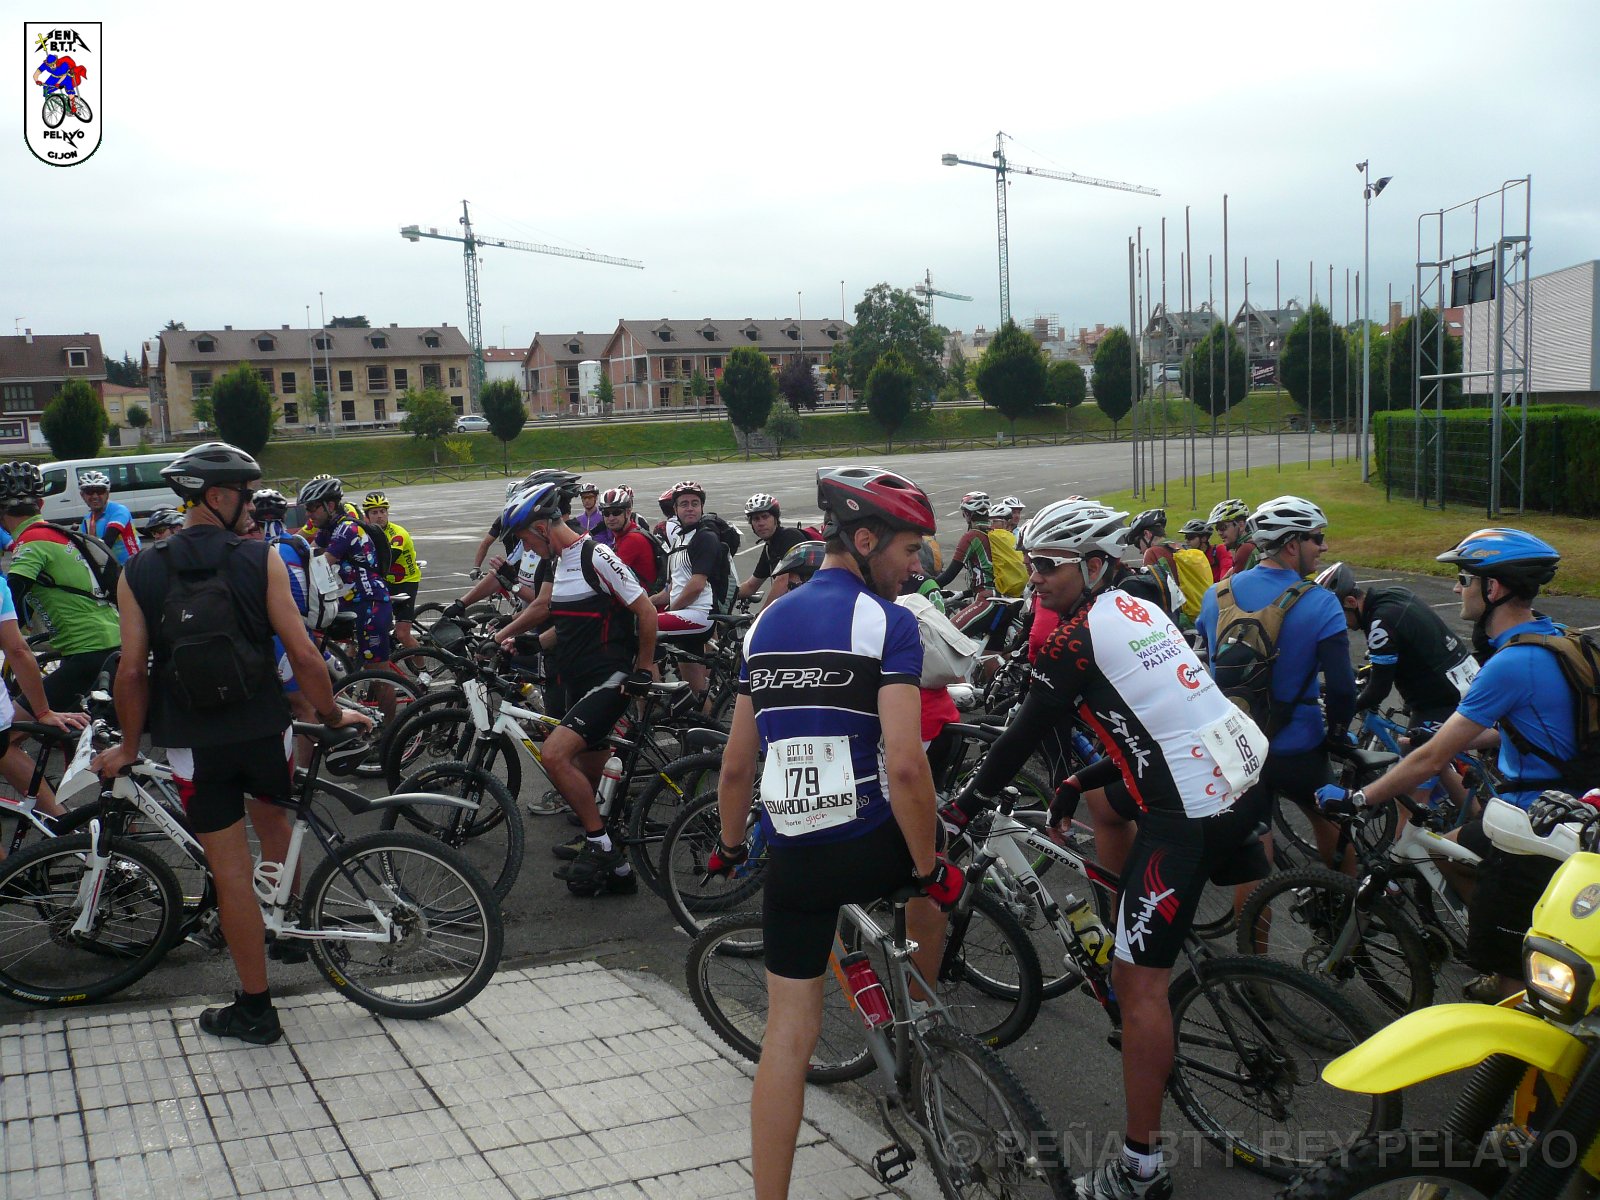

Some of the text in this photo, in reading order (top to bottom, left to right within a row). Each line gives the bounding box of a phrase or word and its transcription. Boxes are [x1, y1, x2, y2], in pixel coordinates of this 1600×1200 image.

[359, 567, 374, 595] TREK
[1137, 638, 1174, 659] VALGRANDE
[1142, 645, 1181, 670] PAJARES
[787, 743, 813, 756] BTT 18
[1235, 734, 1253, 762] 18
[1243, 755, 1260, 777] HUGO
[784, 766, 820, 799] 179
[811, 792, 853, 811] JESUS
